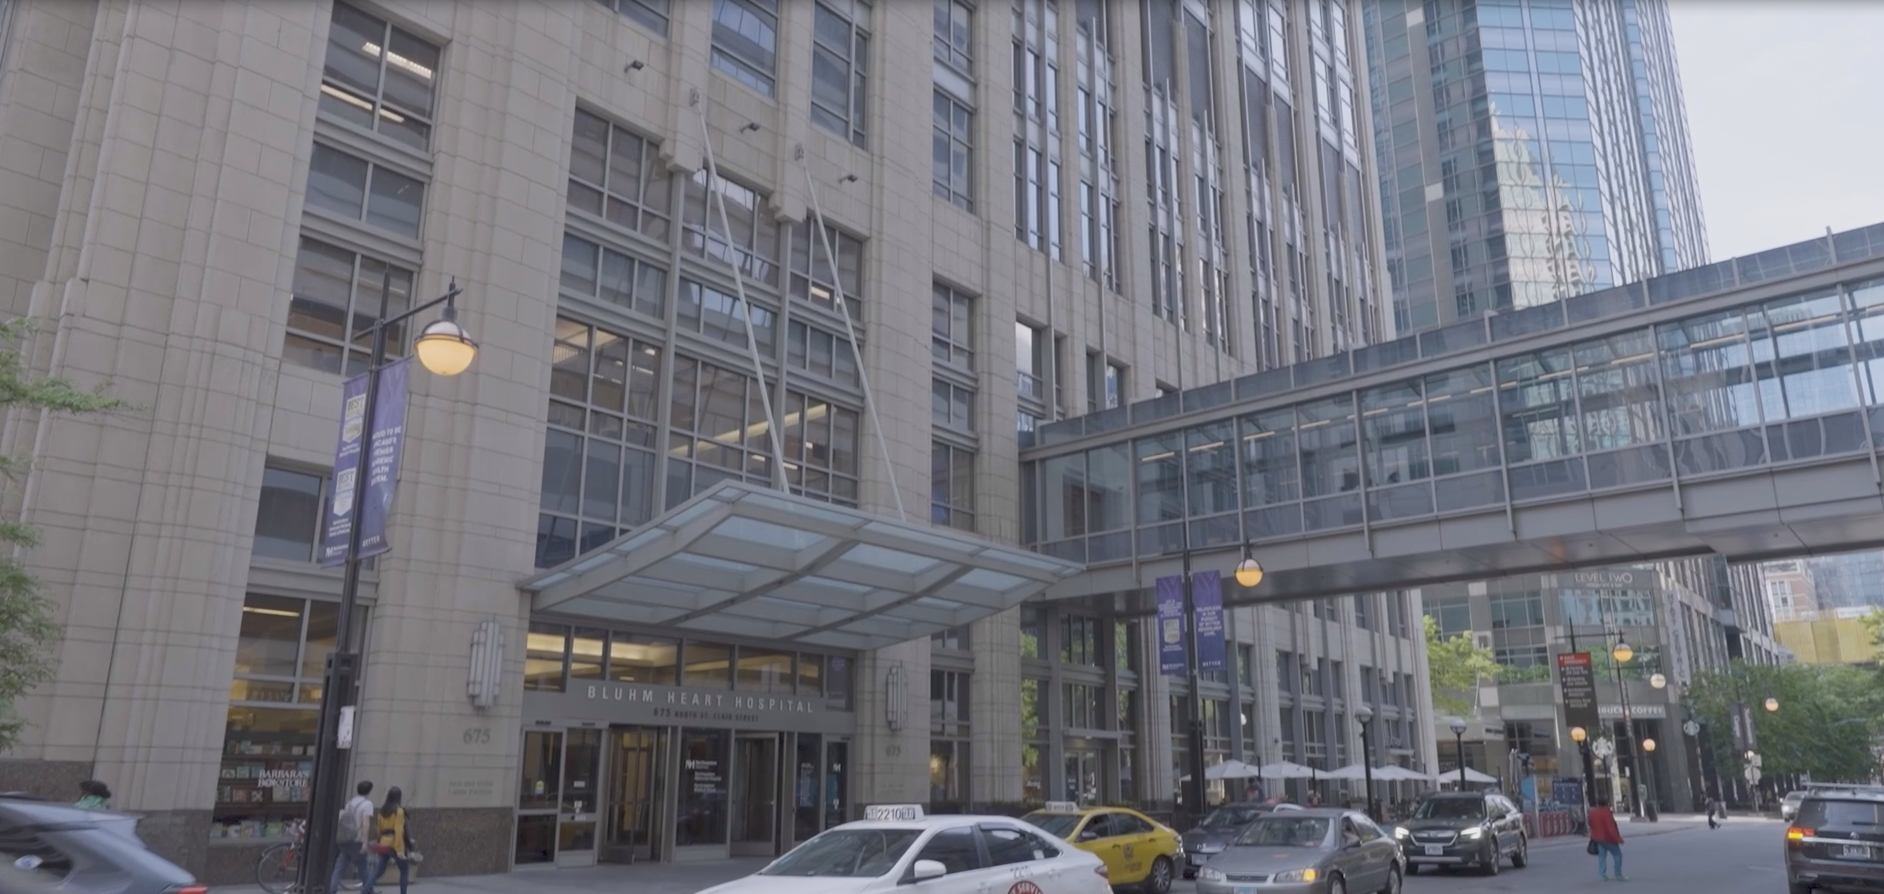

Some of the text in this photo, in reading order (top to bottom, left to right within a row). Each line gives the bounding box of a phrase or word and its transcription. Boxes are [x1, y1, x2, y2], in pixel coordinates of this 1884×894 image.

[1574, 572, 1633, 584] LEVEL TWO
[587, 685, 813, 713] BLUHM HEART HOSPITAL
[653, 707, 671, 718] 675
[674, 710, 697, 719] NORTH
[713, 712, 733, 721] CLAIR
[735, 713, 759, 722] STREET
[1631, 706, 1662, 714] COFFEE
[463, 728, 491, 745] 675
[885, 744, 901, 758] 675
[259, 769, 310, 779] BARBARA'S
[877, 808, 902, 820] 2210
